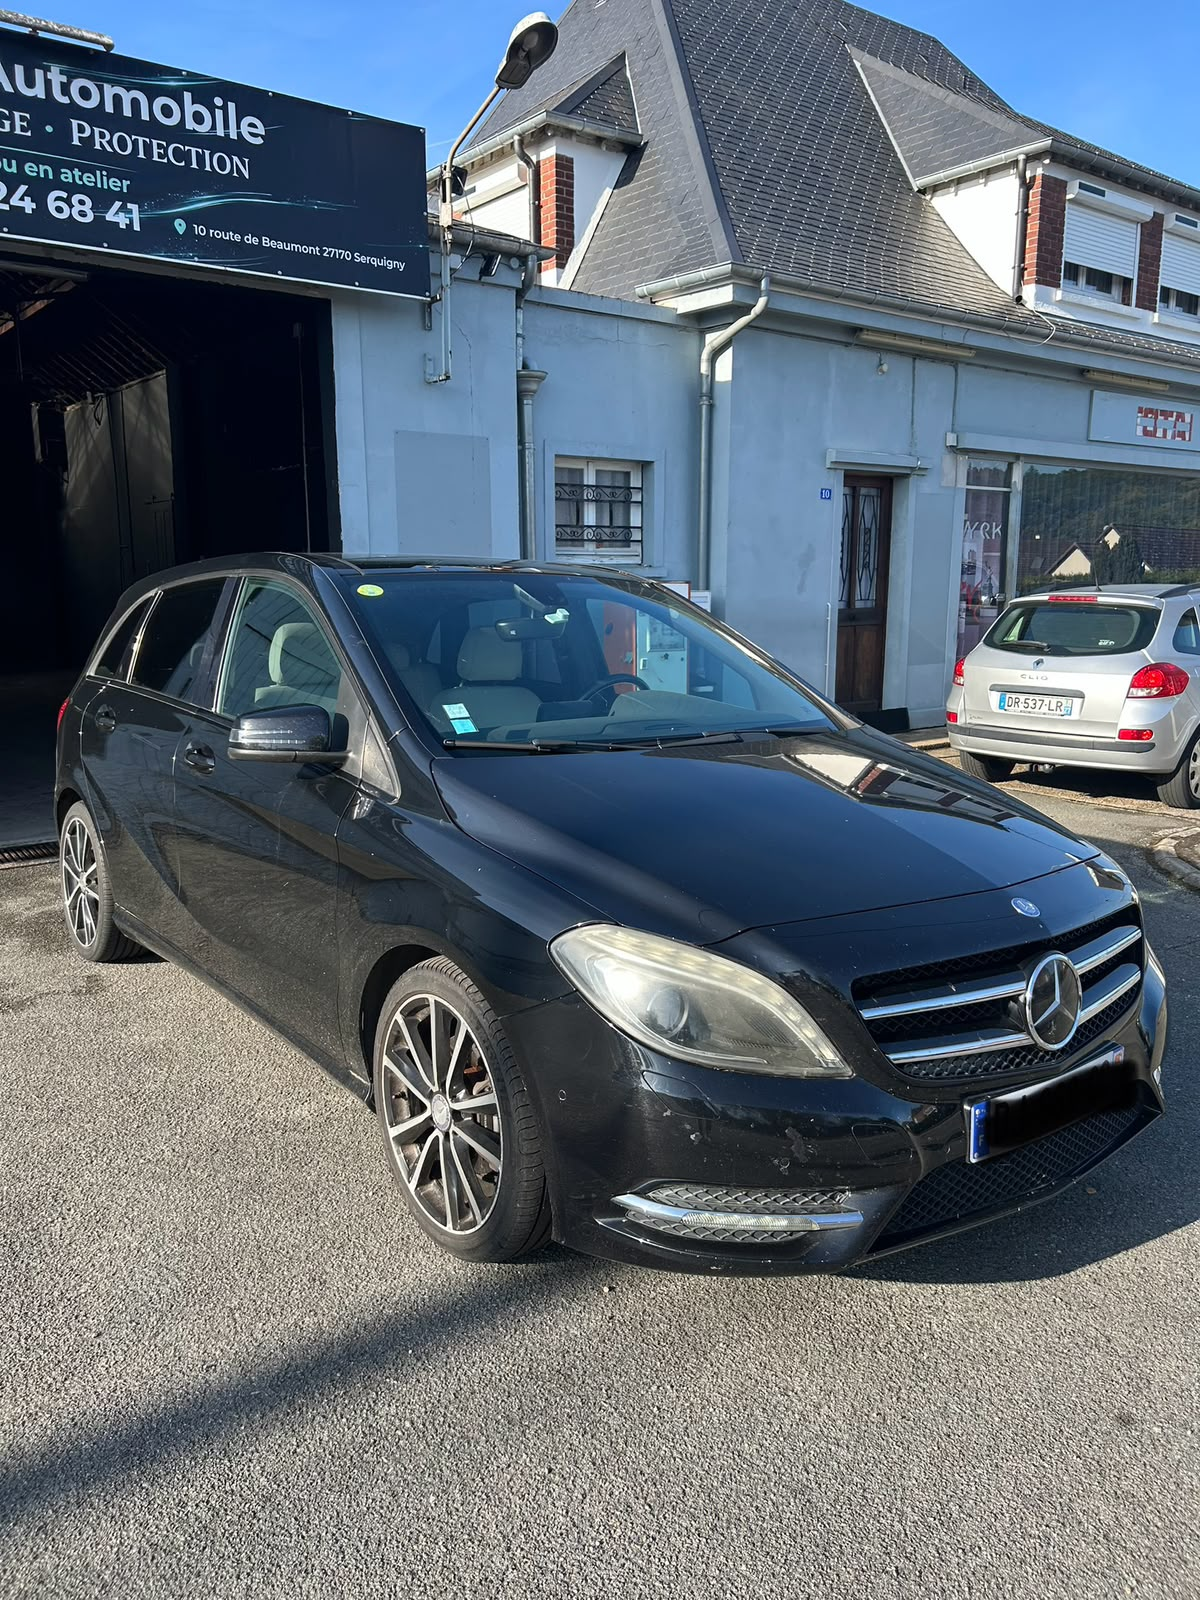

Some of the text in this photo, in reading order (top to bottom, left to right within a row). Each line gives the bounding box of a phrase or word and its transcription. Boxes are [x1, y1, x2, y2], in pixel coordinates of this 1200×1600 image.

[69, 117, 250, 180] PROTECTION
[0, 157, 131, 193] u en atelier
[46, 189, 95, 223] 68
[105, 200, 141, 232] 41
[192, 223, 406, 271] 10 route de Beaumont 27170 Serquigny
[822, 489, 830, 499] 10
